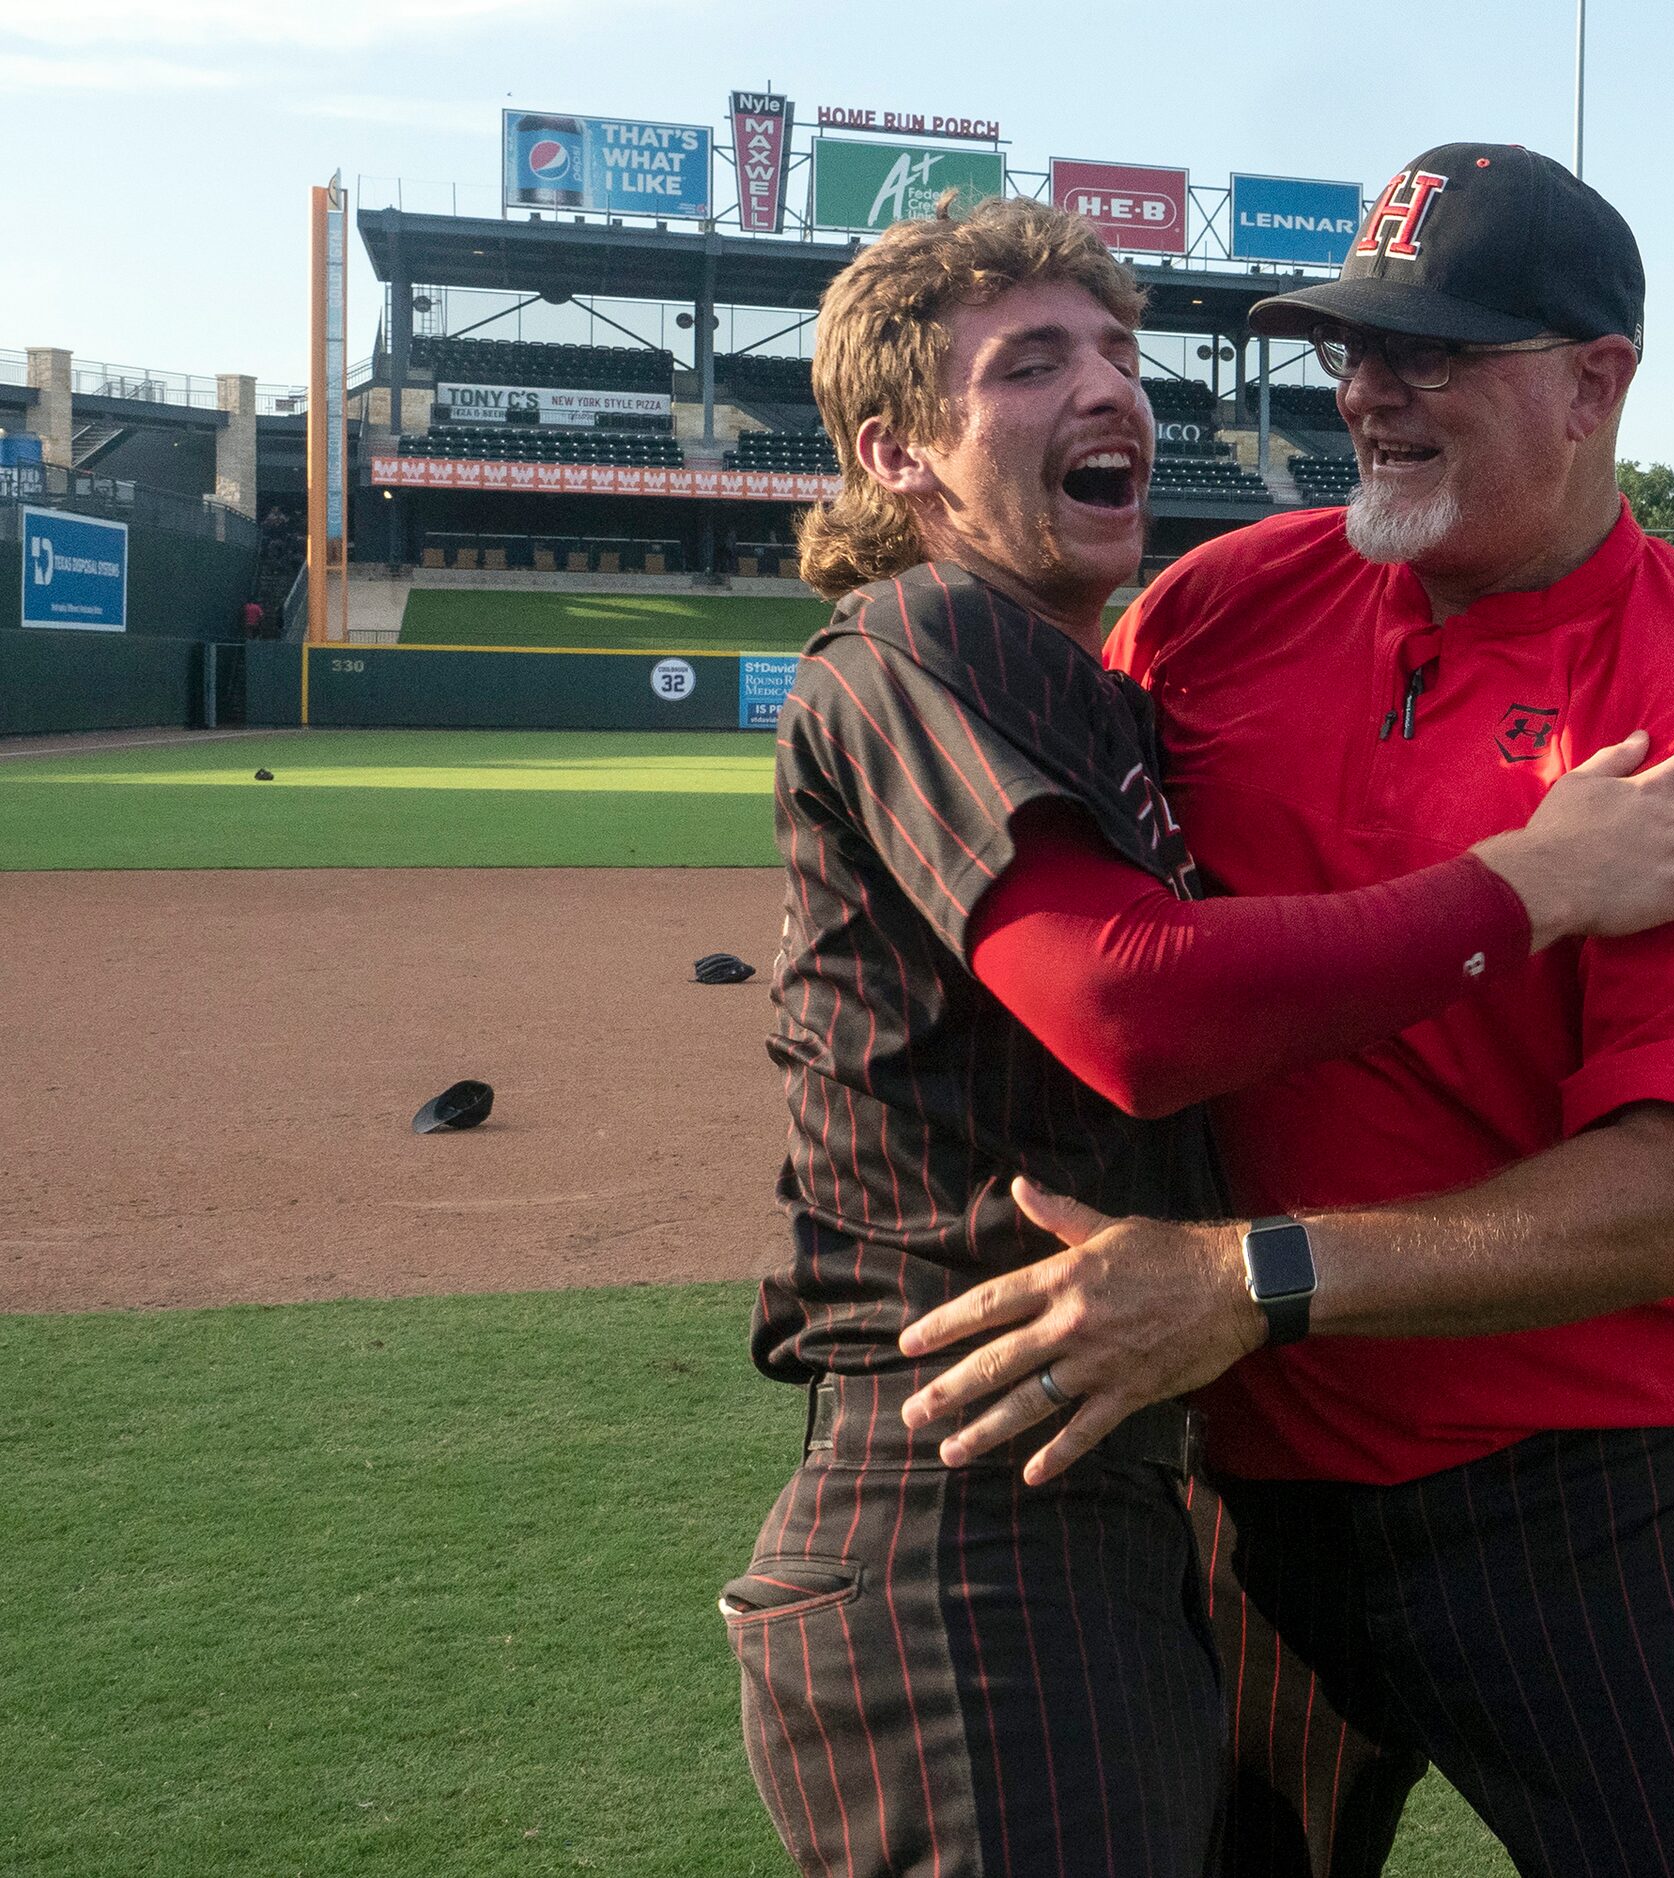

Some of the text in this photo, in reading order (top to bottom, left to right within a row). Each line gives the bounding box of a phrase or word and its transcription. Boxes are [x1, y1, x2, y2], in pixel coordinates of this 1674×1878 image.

[740, 94, 780, 113] Nyle
[818, 106, 999, 138] HOME RUN PORCH
[601, 123, 699, 150] THAT'S
[601, 147, 685, 172] WHAT
[605, 170, 682, 195] I LIKE
[744, 118, 775, 227] MAXWELL
[908, 187, 940, 200] Fede
[1240, 211, 1355, 234] LENNAR
[1356, 170, 1449, 261] H
[448, 388, 539, 410] TONY C'S
[551, 395, 662, 410] NEW YORK STYLE PIZZA
[331, 659, 365, 673] 330
[661, 674, 685, 692] 32
[755, 704, 767, 714] IS
